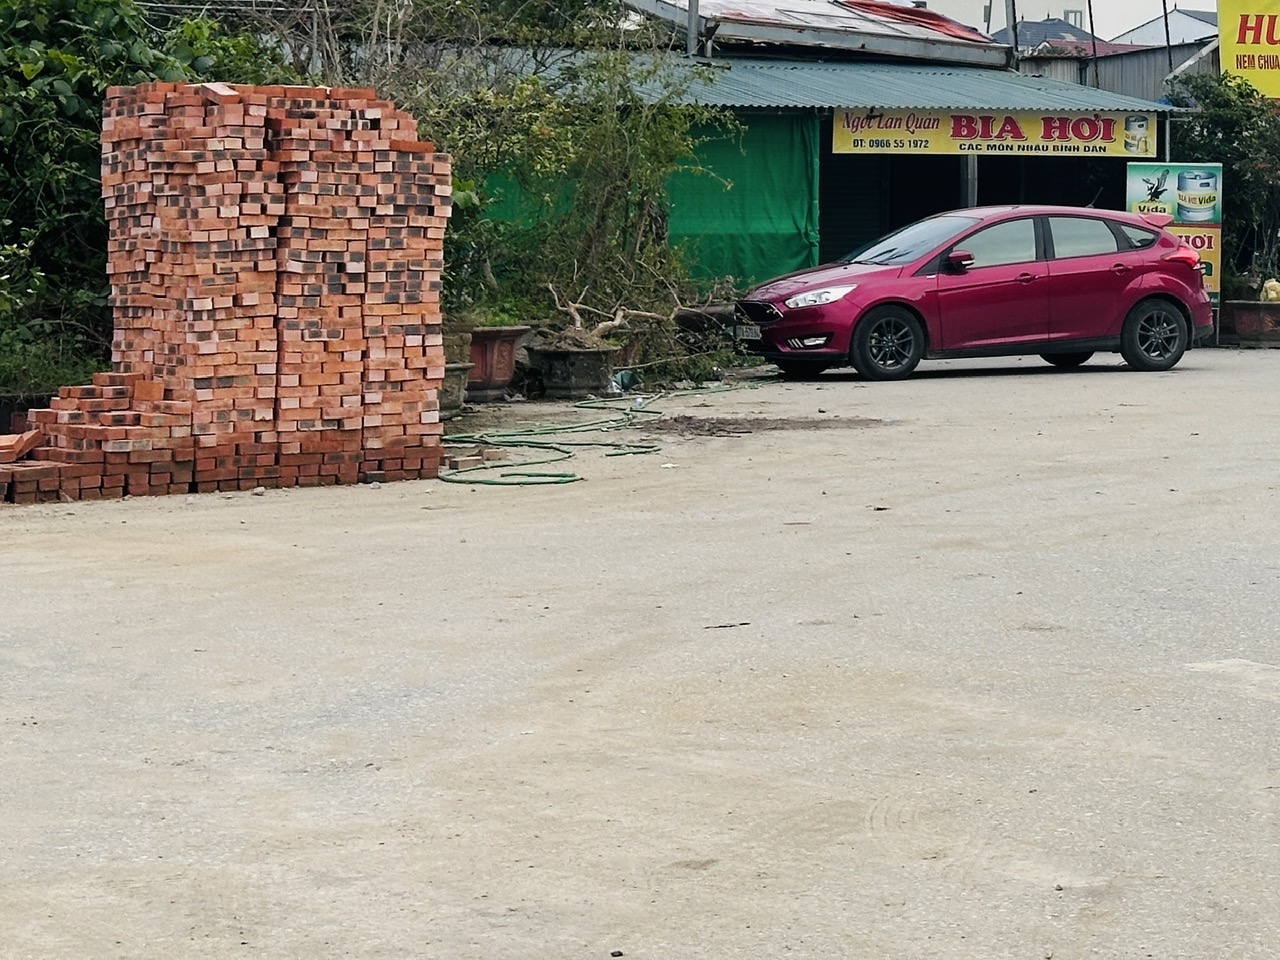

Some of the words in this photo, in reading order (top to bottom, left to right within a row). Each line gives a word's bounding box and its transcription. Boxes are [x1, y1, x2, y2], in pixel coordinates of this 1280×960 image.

[1236, 54, 1255, 70] NEM
[1258, 54, 1280, 70] CHUA
[877, 114, 902, 130] Lan
[905, 111, 940, 135] Quán
[949, 114, 1026, 141] BIA
[1040, 113, 1117, 143] HƠI
[908, 139, 929, 149] 1972
[1198, 195, 1216, 205] Vida
[1138, 205, 1167, 214] Vida
